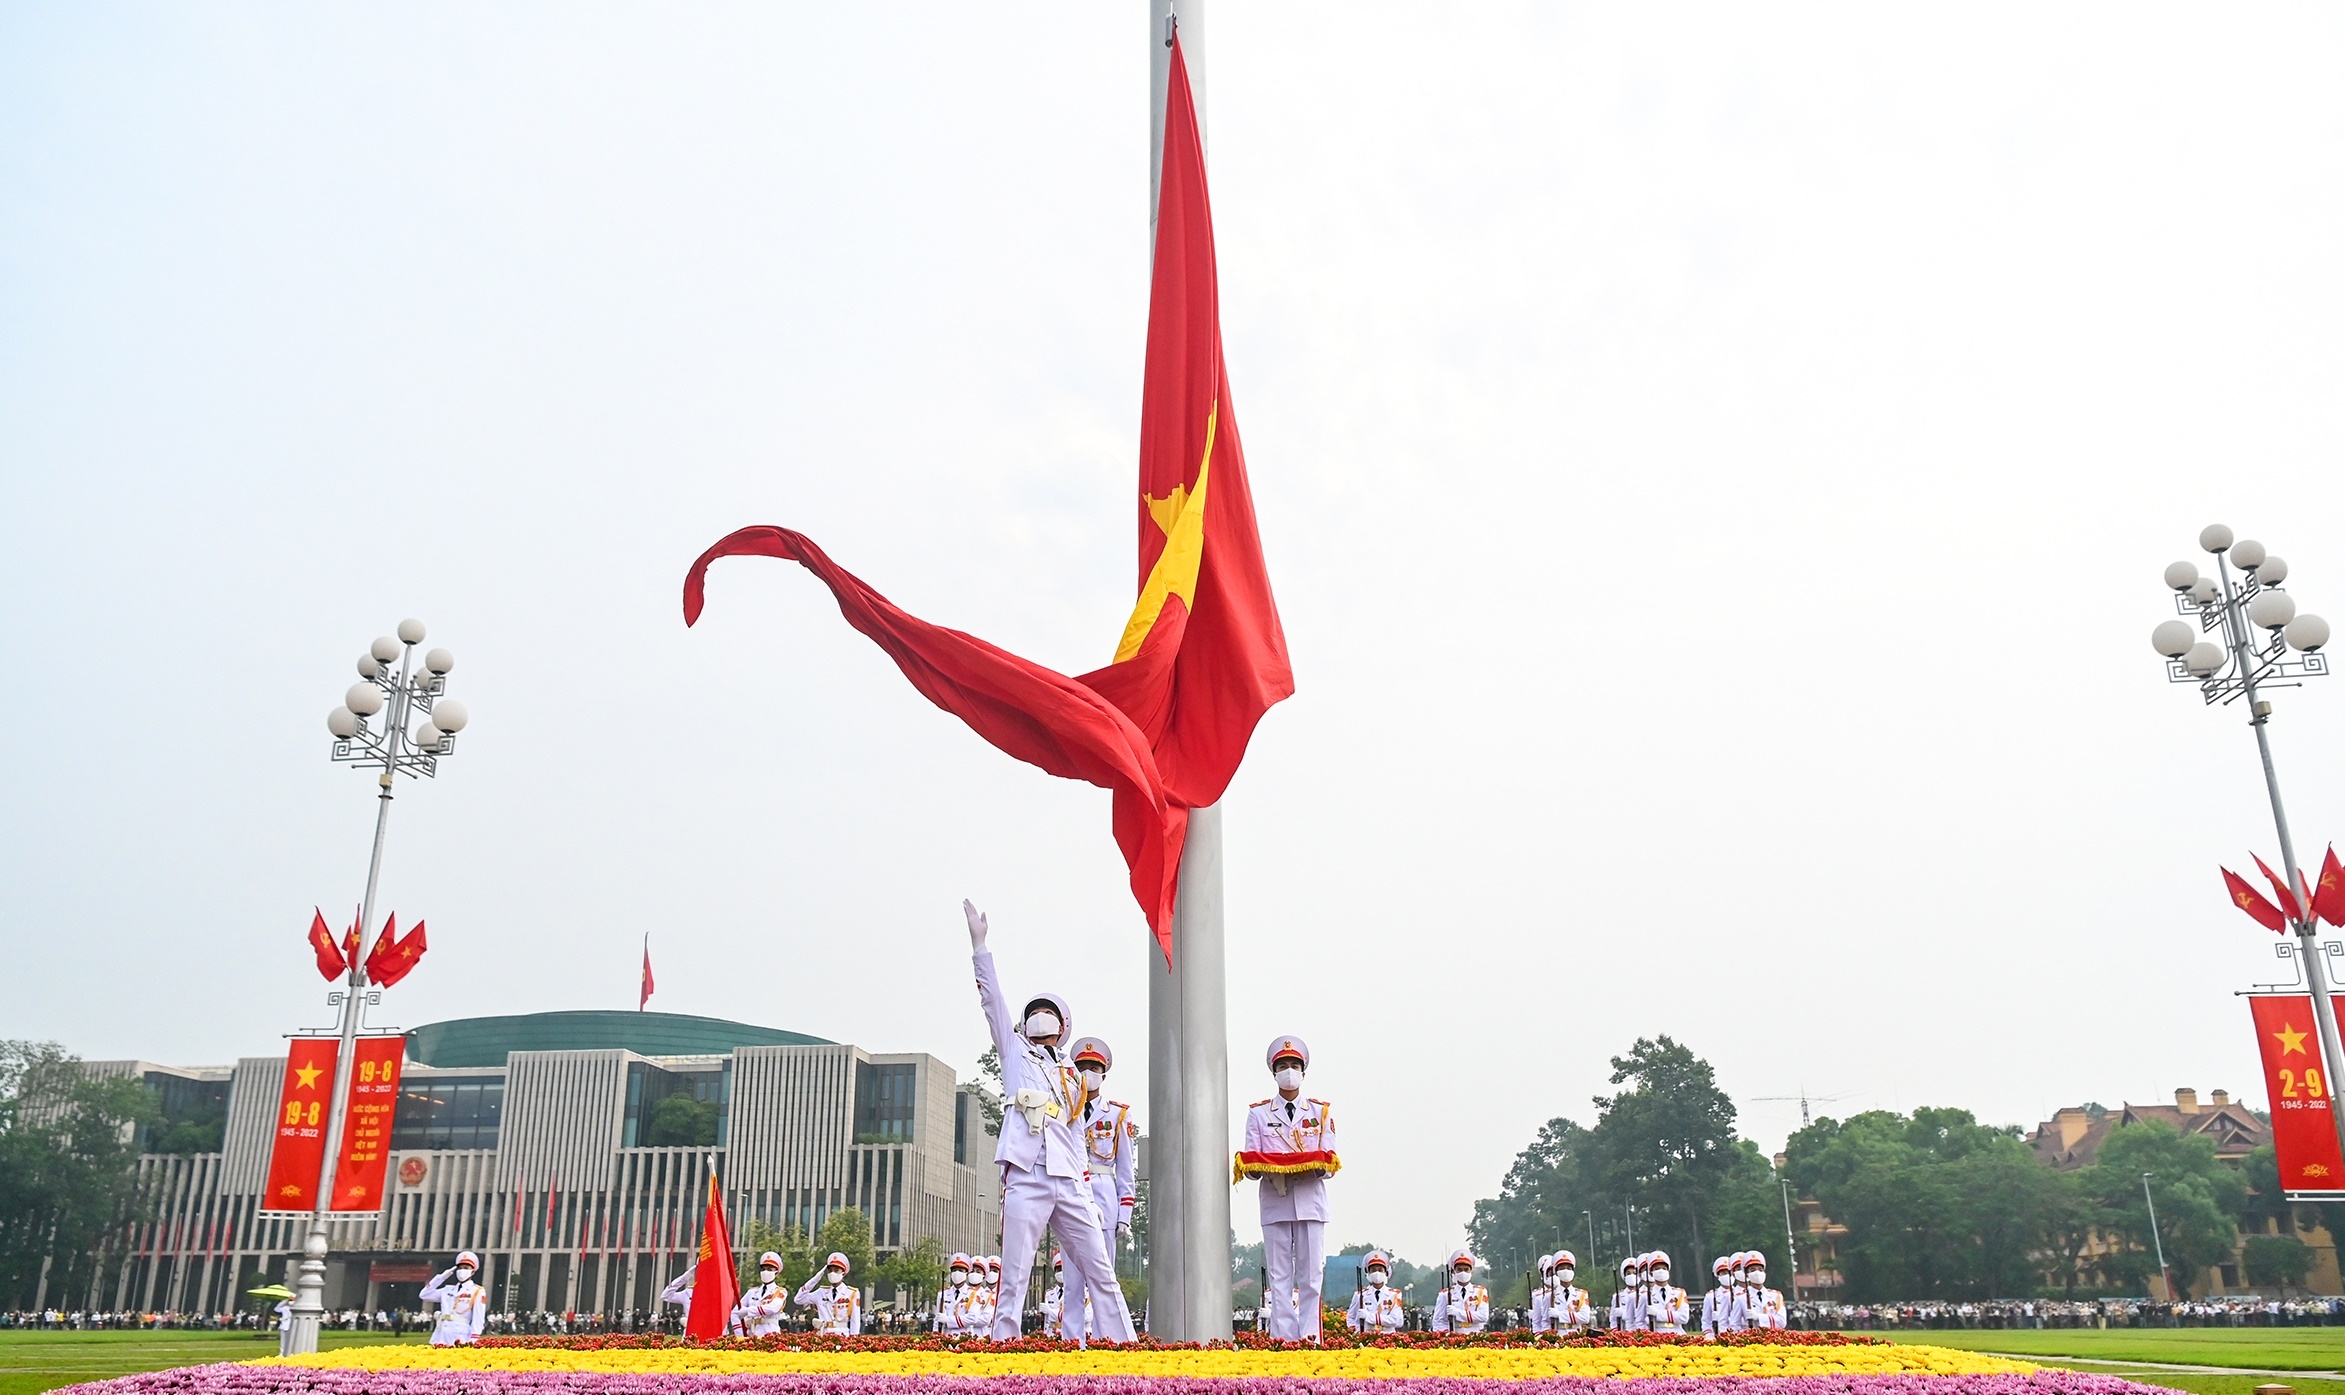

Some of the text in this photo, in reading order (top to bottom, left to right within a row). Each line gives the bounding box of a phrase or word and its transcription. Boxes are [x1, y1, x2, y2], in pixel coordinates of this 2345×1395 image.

[359, 1060, 393, 1083] 19-8
[2279, 1068, 2323, 1098] 2-9
[285, 1100, 321, 1126] 19-8
[699, 1226, 713, 1262] ẮNG
